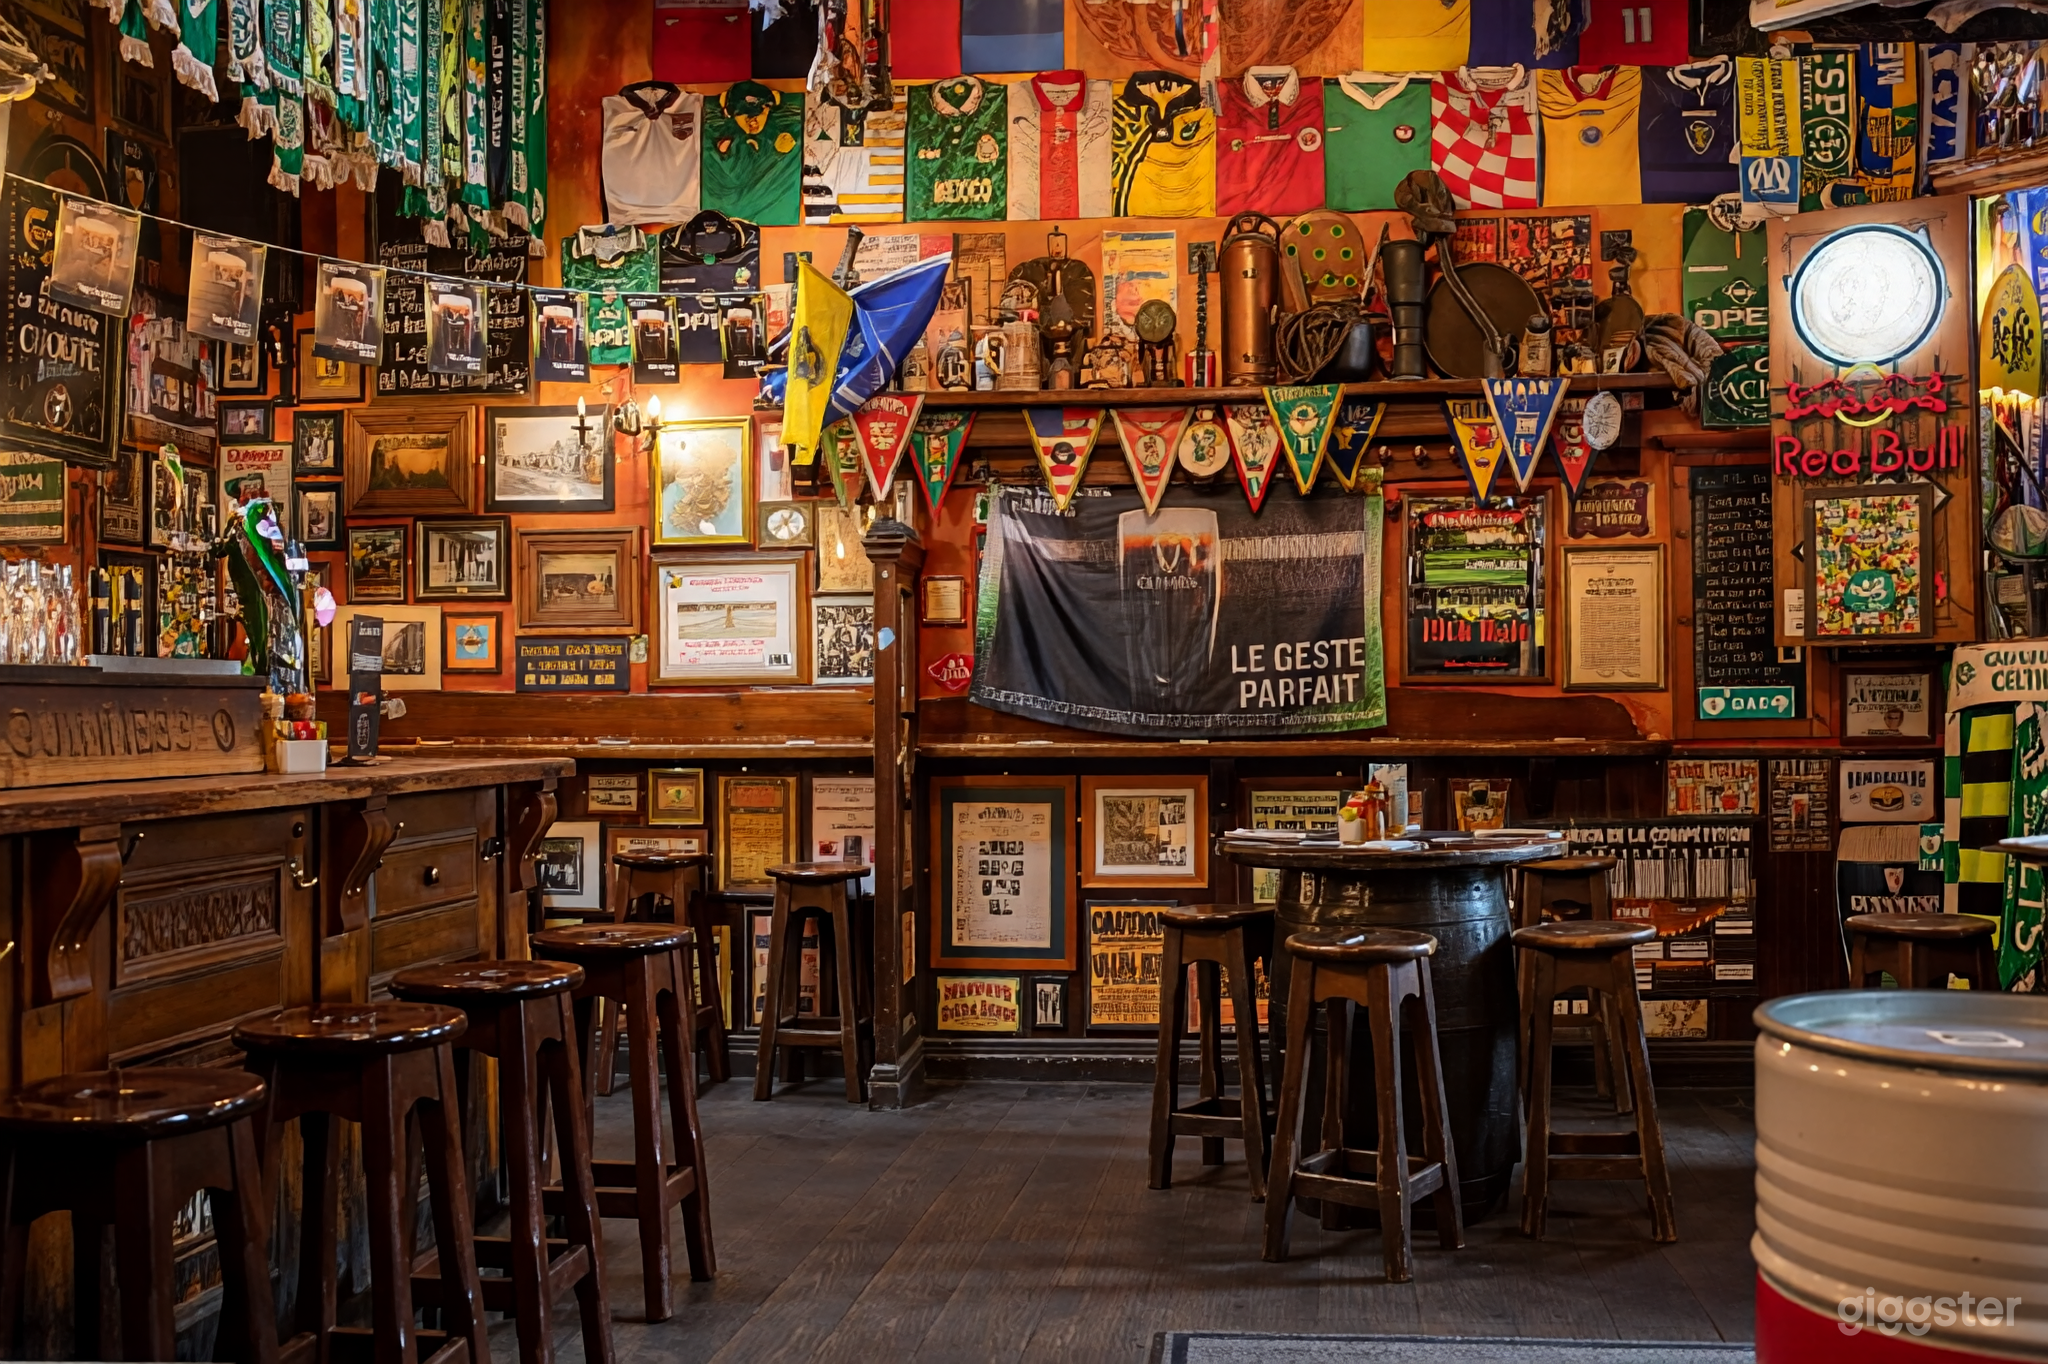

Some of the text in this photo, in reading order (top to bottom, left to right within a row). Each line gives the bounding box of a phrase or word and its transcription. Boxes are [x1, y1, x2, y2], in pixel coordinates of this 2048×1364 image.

[1622, 7, 1652, 43] 11
[1870, 427, 1957, 474] Bull
[1231, 637, 1365, 674] LE GESTE
[1240, 673, 1360, 708] PARFAIT
